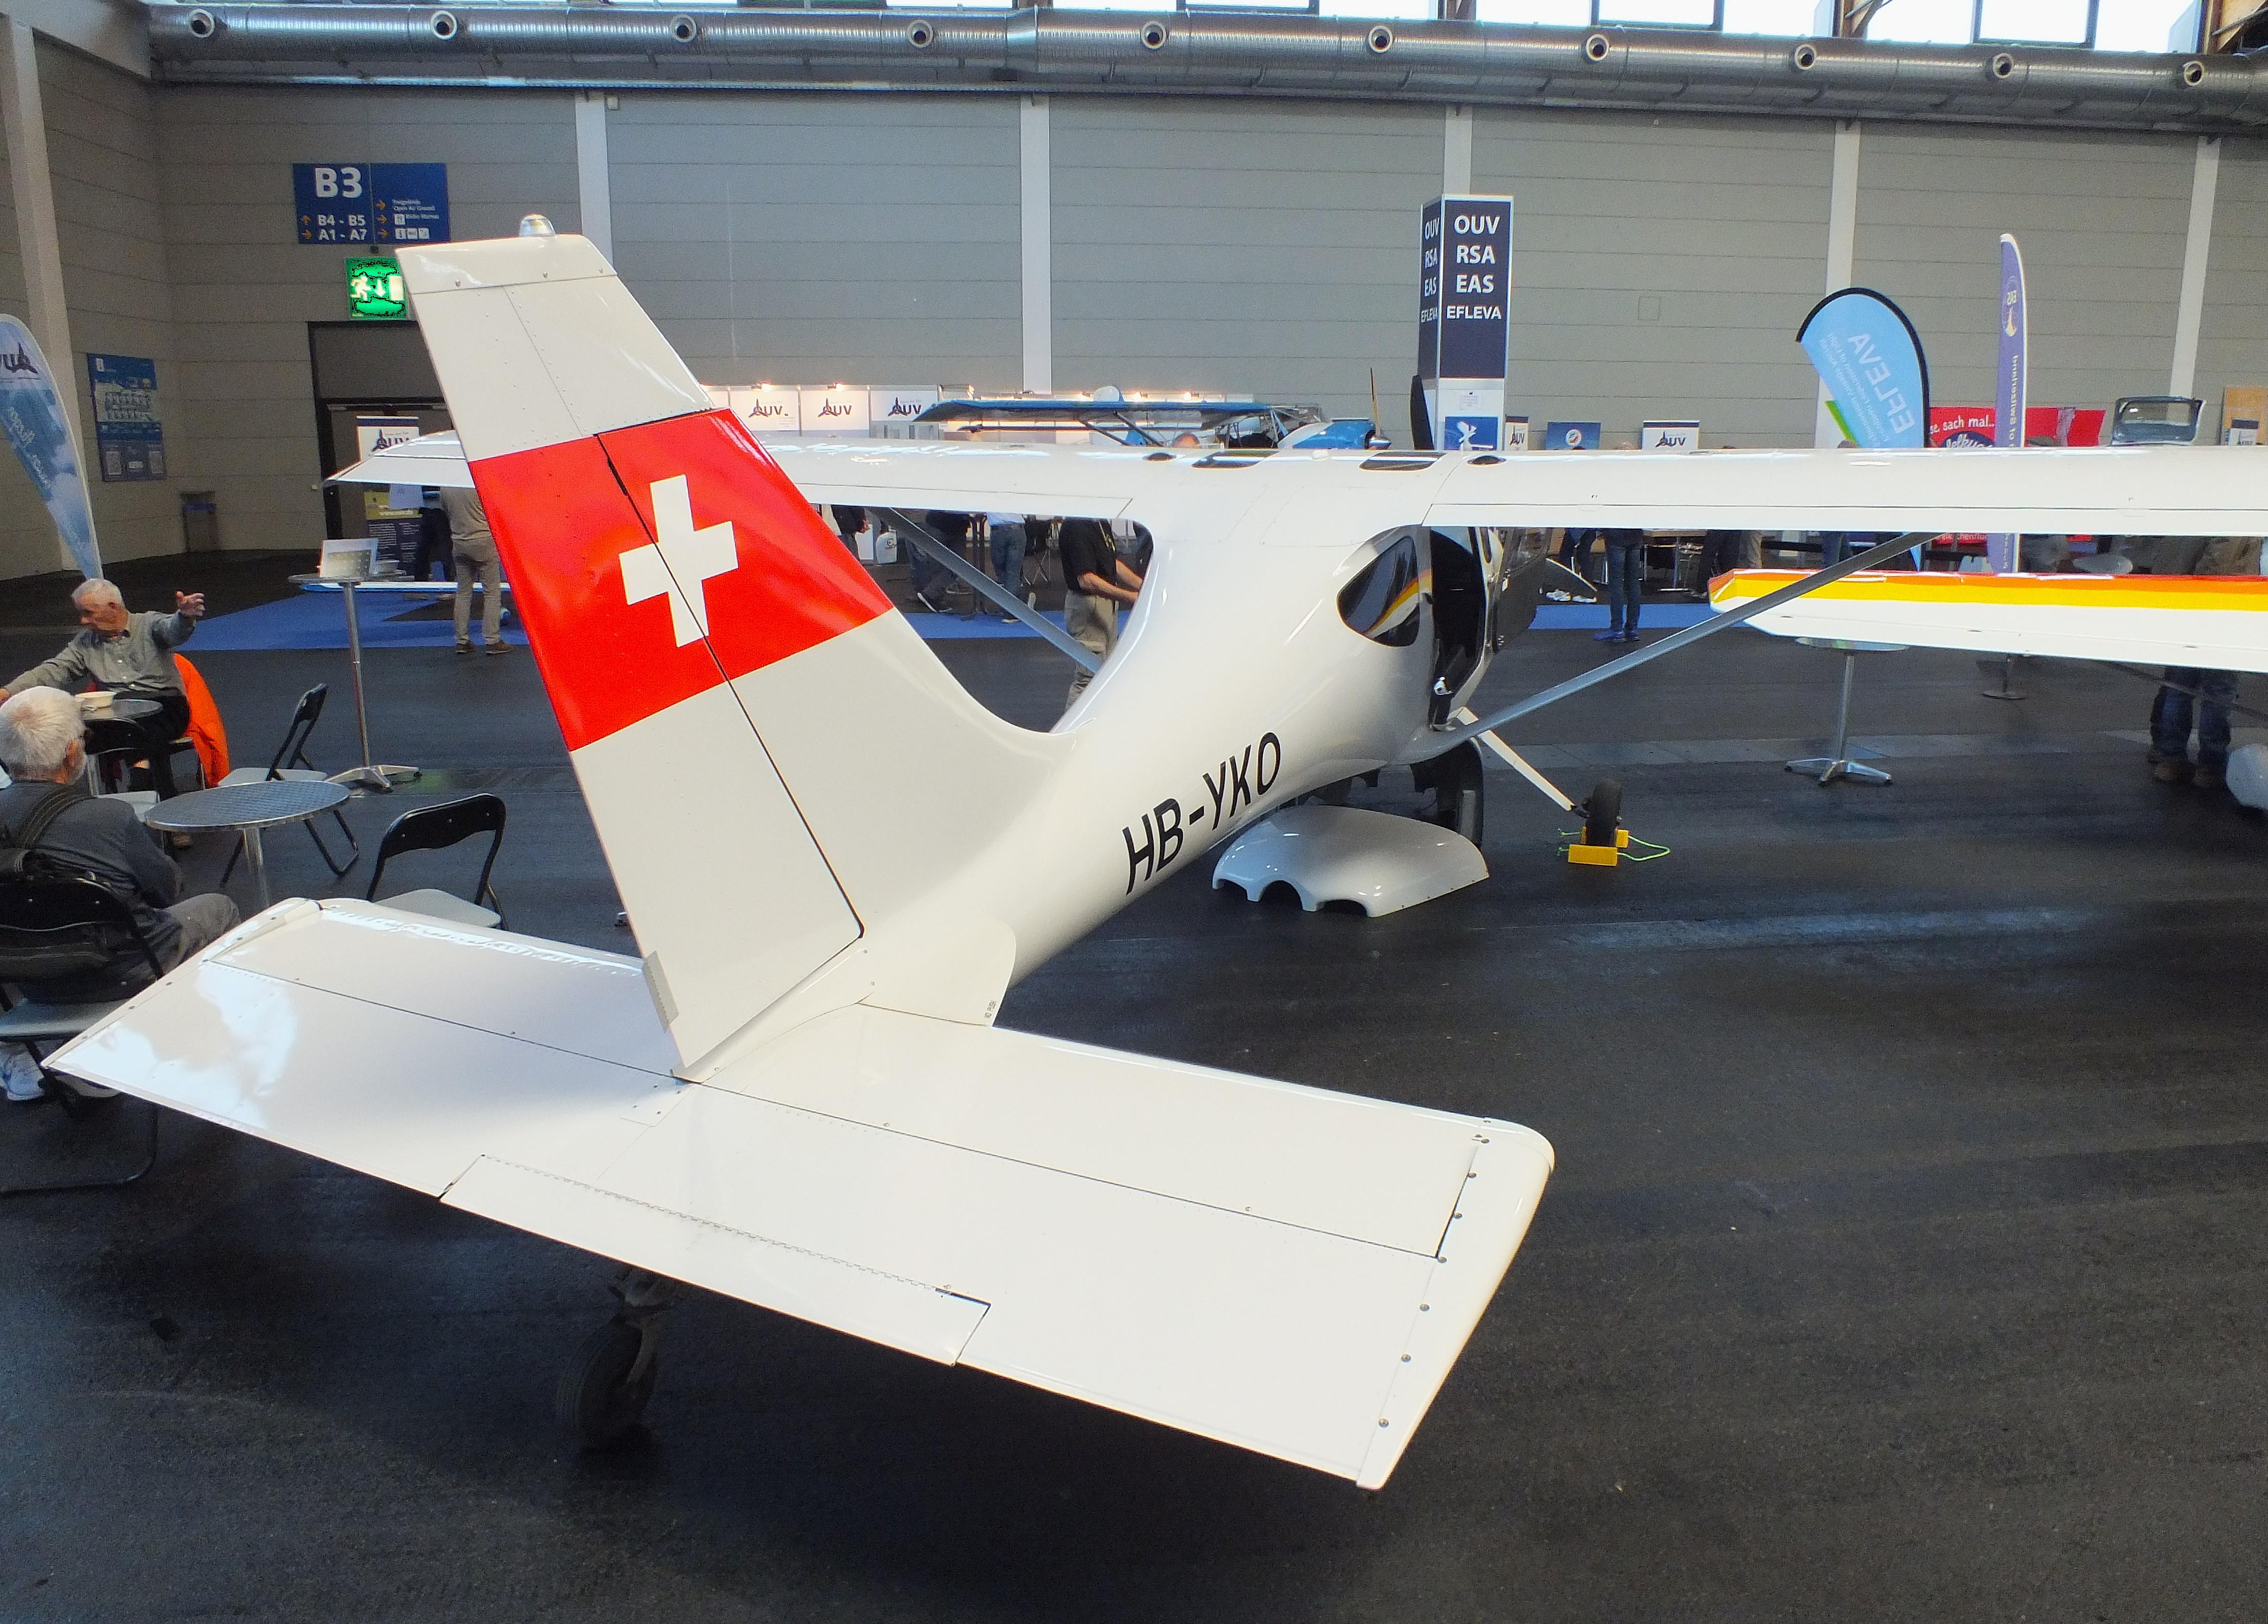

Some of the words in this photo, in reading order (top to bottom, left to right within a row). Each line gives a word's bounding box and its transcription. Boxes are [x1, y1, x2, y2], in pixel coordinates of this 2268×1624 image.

[314, 167, 363, 198] B3
[316, 214, 335, 226] B4
[348, 214, 366, 226] B5
[1424, 217, 1440, 240] OUV
[1454, 215, 1501, 235] OUV
[318, 229, 336, 241] A1
[350, 229, 367, 241] A7
[1424, 248, 1438, 269] RSA
[1456, 245, 1496, 264] RSA
[1424, 277, 1437, 297] EAS
[1456, 274, 1494, 294] EAS
[1421, 308, 1438, 323] EFLEVA
[1447, 306, 1502, 320] EFLEVA
[1943, 415, 1964, 431] sach
[1122, 731, 1280, 896] HB-YKO
